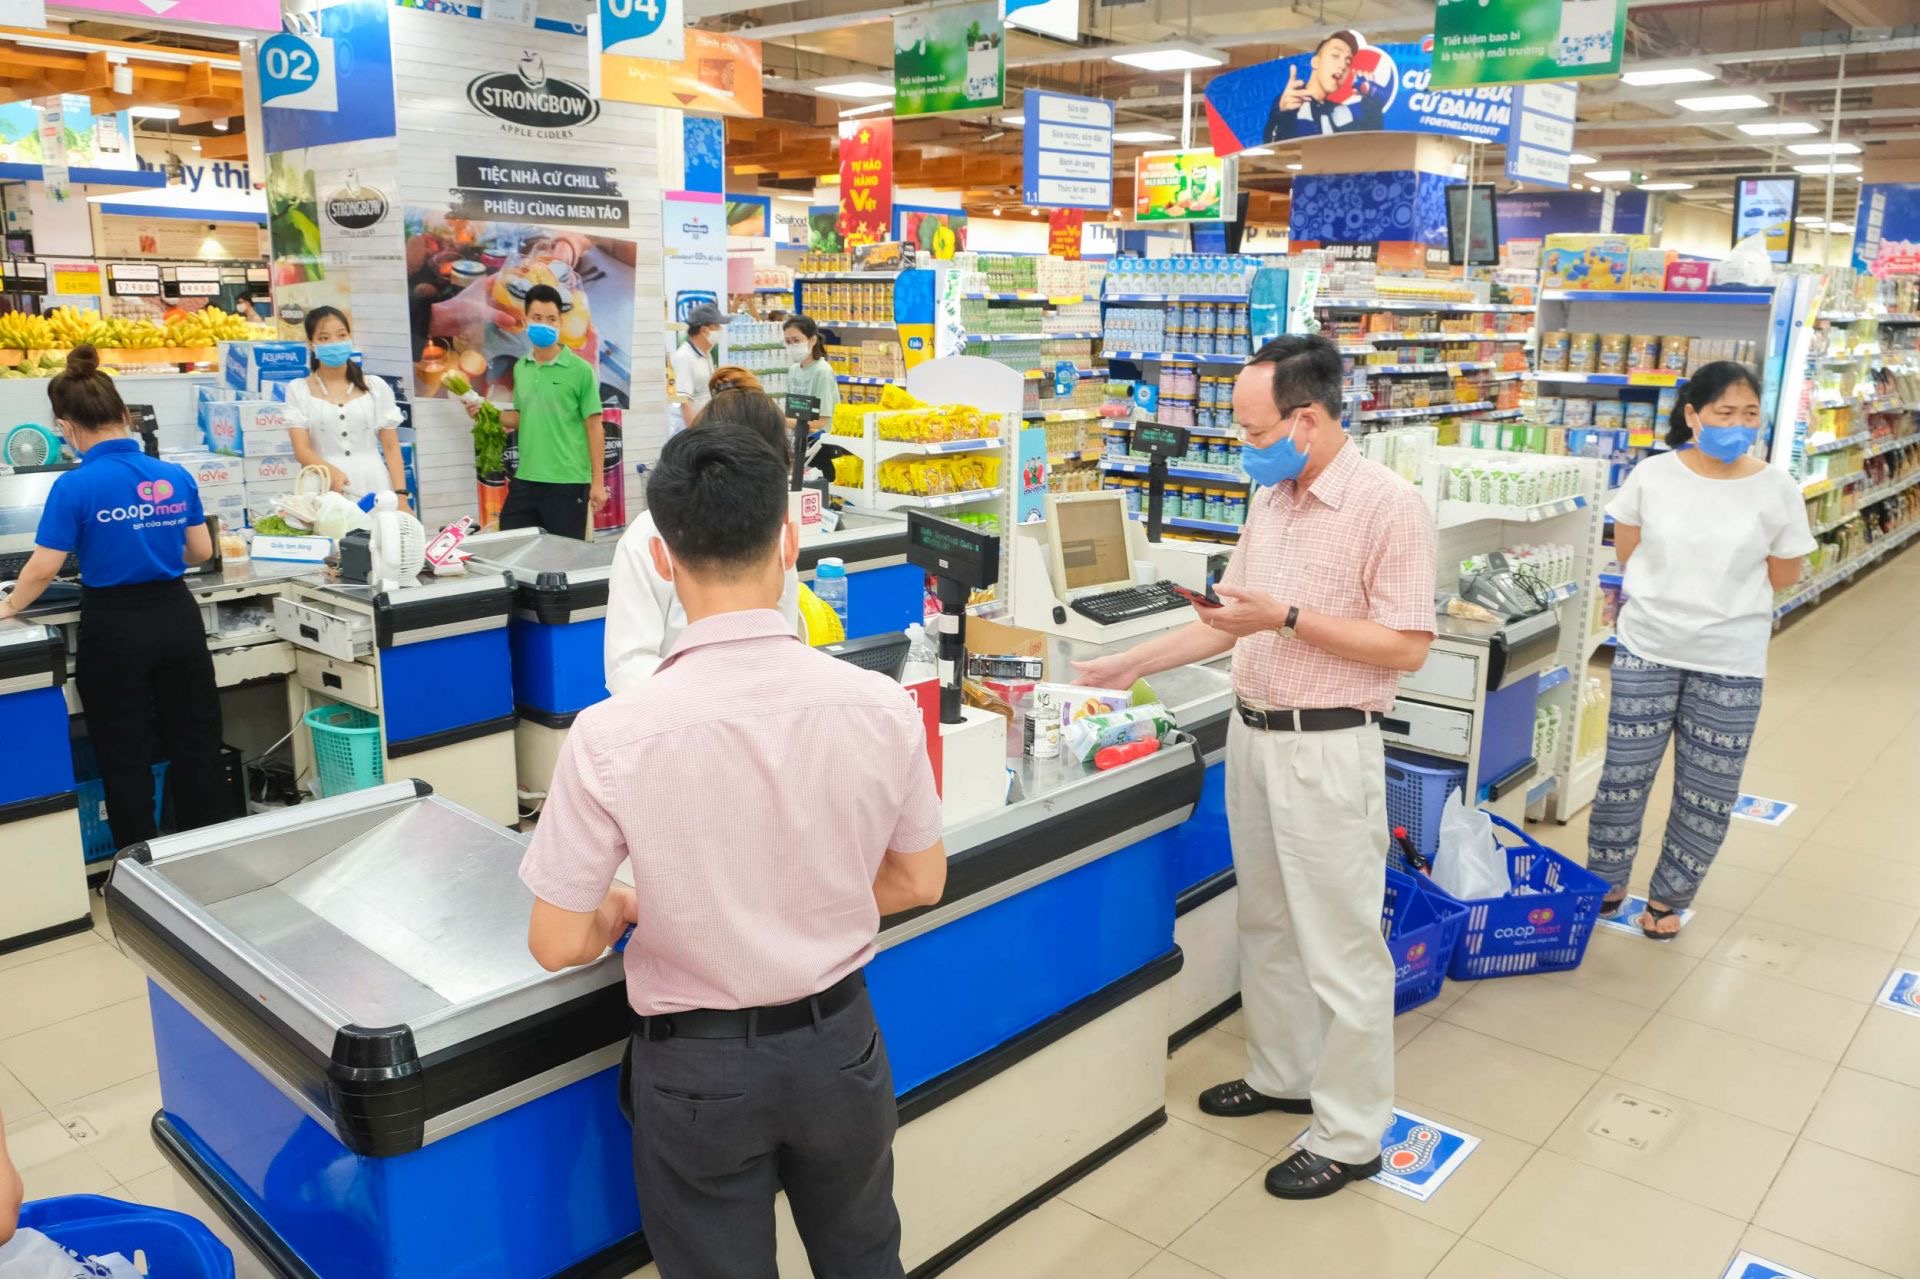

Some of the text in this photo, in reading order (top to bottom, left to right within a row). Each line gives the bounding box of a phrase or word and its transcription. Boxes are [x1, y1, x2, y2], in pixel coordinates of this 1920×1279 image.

[1443, 35, 1461, 46] Tiết
[1463, 34, 1487, 45] kiệm
[1489, 32, 1508, 43] bao
[266, 47, 313, 81] 02
[482, 86, 586, 116] STRONGBOW
[1485, 106, 1510, 125] M
[500, 124, 573, 139] APPLE CIDERS
[212, 161, 265, 195] thị
[478, 166, 508, 184] TIỆC
[511, 168, 541, 183] NHÀ
[564, 174, 600, 189] CHILL
[1026, 191, 1038, 203] 1.1
[331, 200, 381, 217] STRONGBOW
[484, 198, 622, 219] PHIÊU CÙNG MEN TÁO
[775, 213, 807, 226] Seafood
[261, 351, 299, 363] AQUAFINA
[259, 464, 288, 478] laVie
